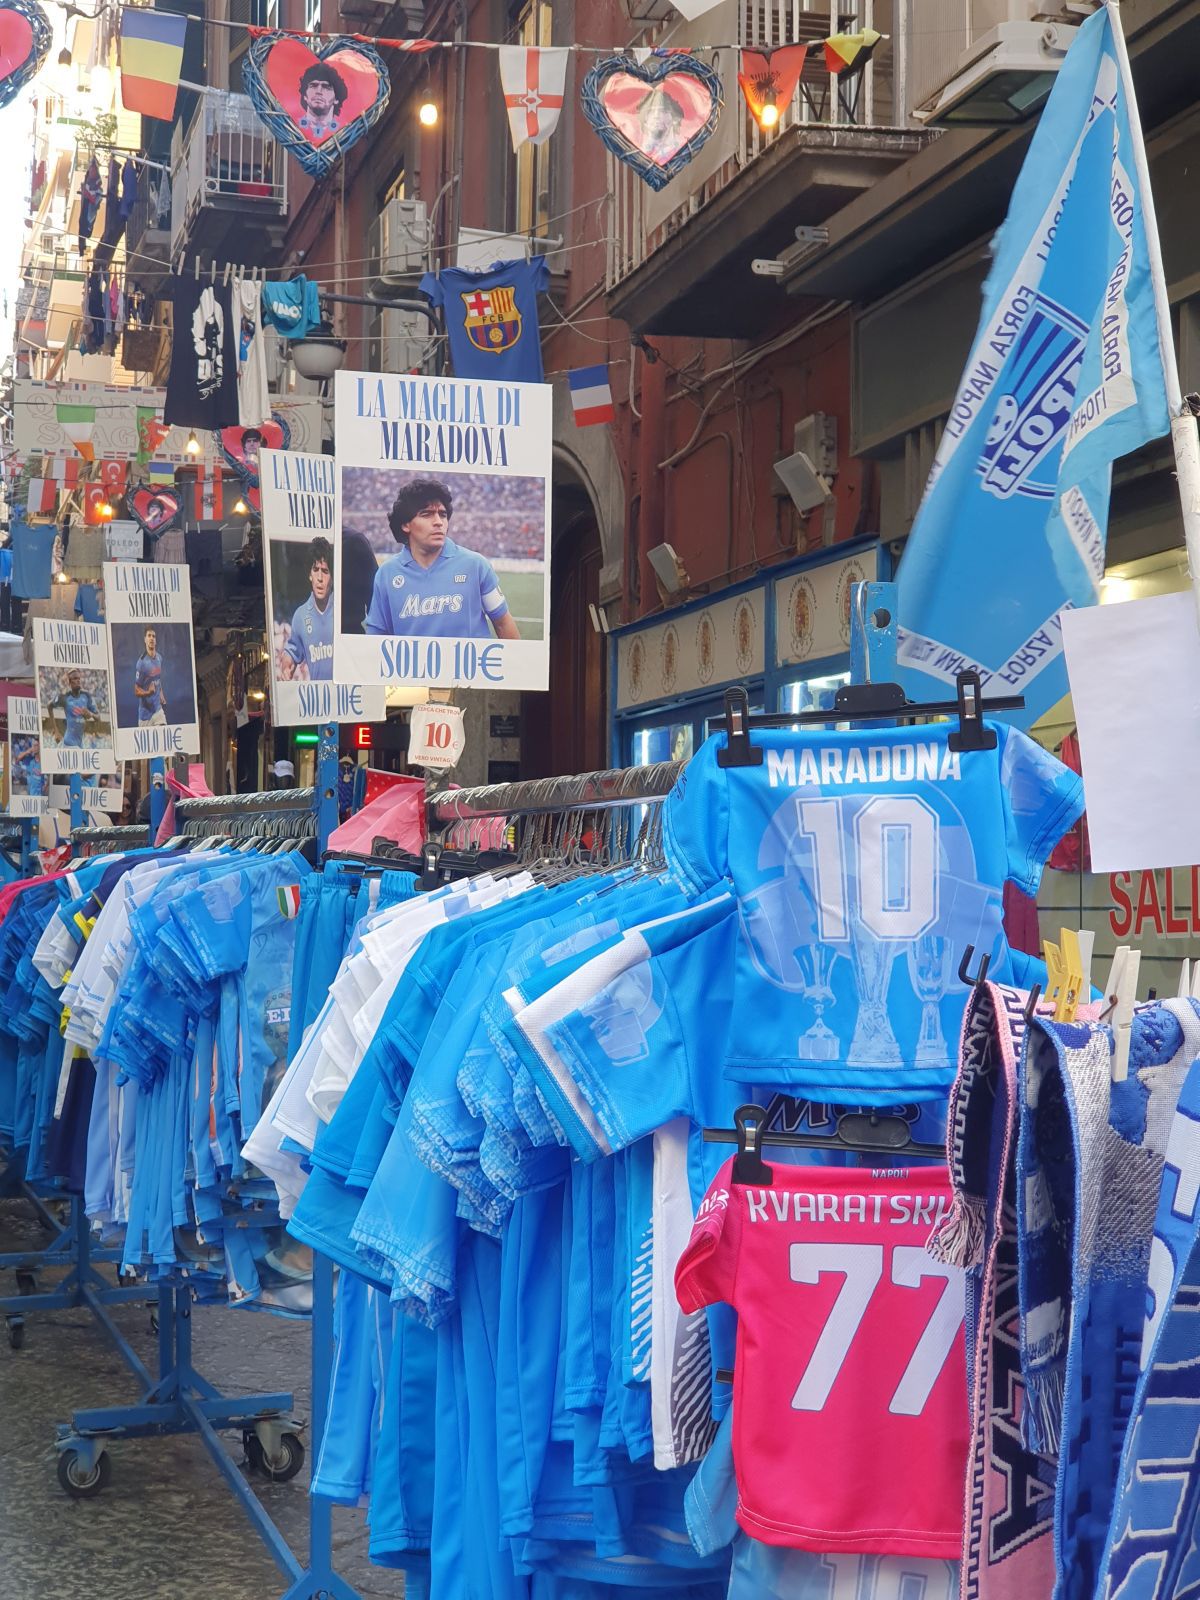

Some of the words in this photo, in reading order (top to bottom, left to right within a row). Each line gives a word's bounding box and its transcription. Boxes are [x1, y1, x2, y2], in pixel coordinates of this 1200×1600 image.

[356, 378, 387, 418] LA
[399, 380, 486, 424] MAGLIA
[497, 387, 521, 426] DI
[380, 421, 509, 466] MARADONA
[273, 455, 291, 490] LA
[295, 457, 335, 494] MAGLI
[289, 493, 335, 529] MARAD
[115, 566, 128, 591] LA
[132, 567, 167, 592] MAGLIA
[170, 568, 180, 592] DI
[129, 592, 171, 617] SIMEONE
[399, 594, 463, 618] Mars
[43, 622, 53, 641] LA
[57, 623, 88, 644] MAGLIA
[90, 626, 99, 645] DI
[380, 639, 441, 679] SOLO
[453, 641, 504, 681] 10€
[298, 683, 331, 718] SOLO
[134, 729, 159, 754] SOLO
[424, 722, 451, 748] 10
[57, 751, 78, 770] SOLO
[767, 742, 962, 788] MARADONA
[796, 793, 940, 942] 10
[871, 1168, 909, 1178] NAPOLI
[789, 1242, 966, 1417] 77
